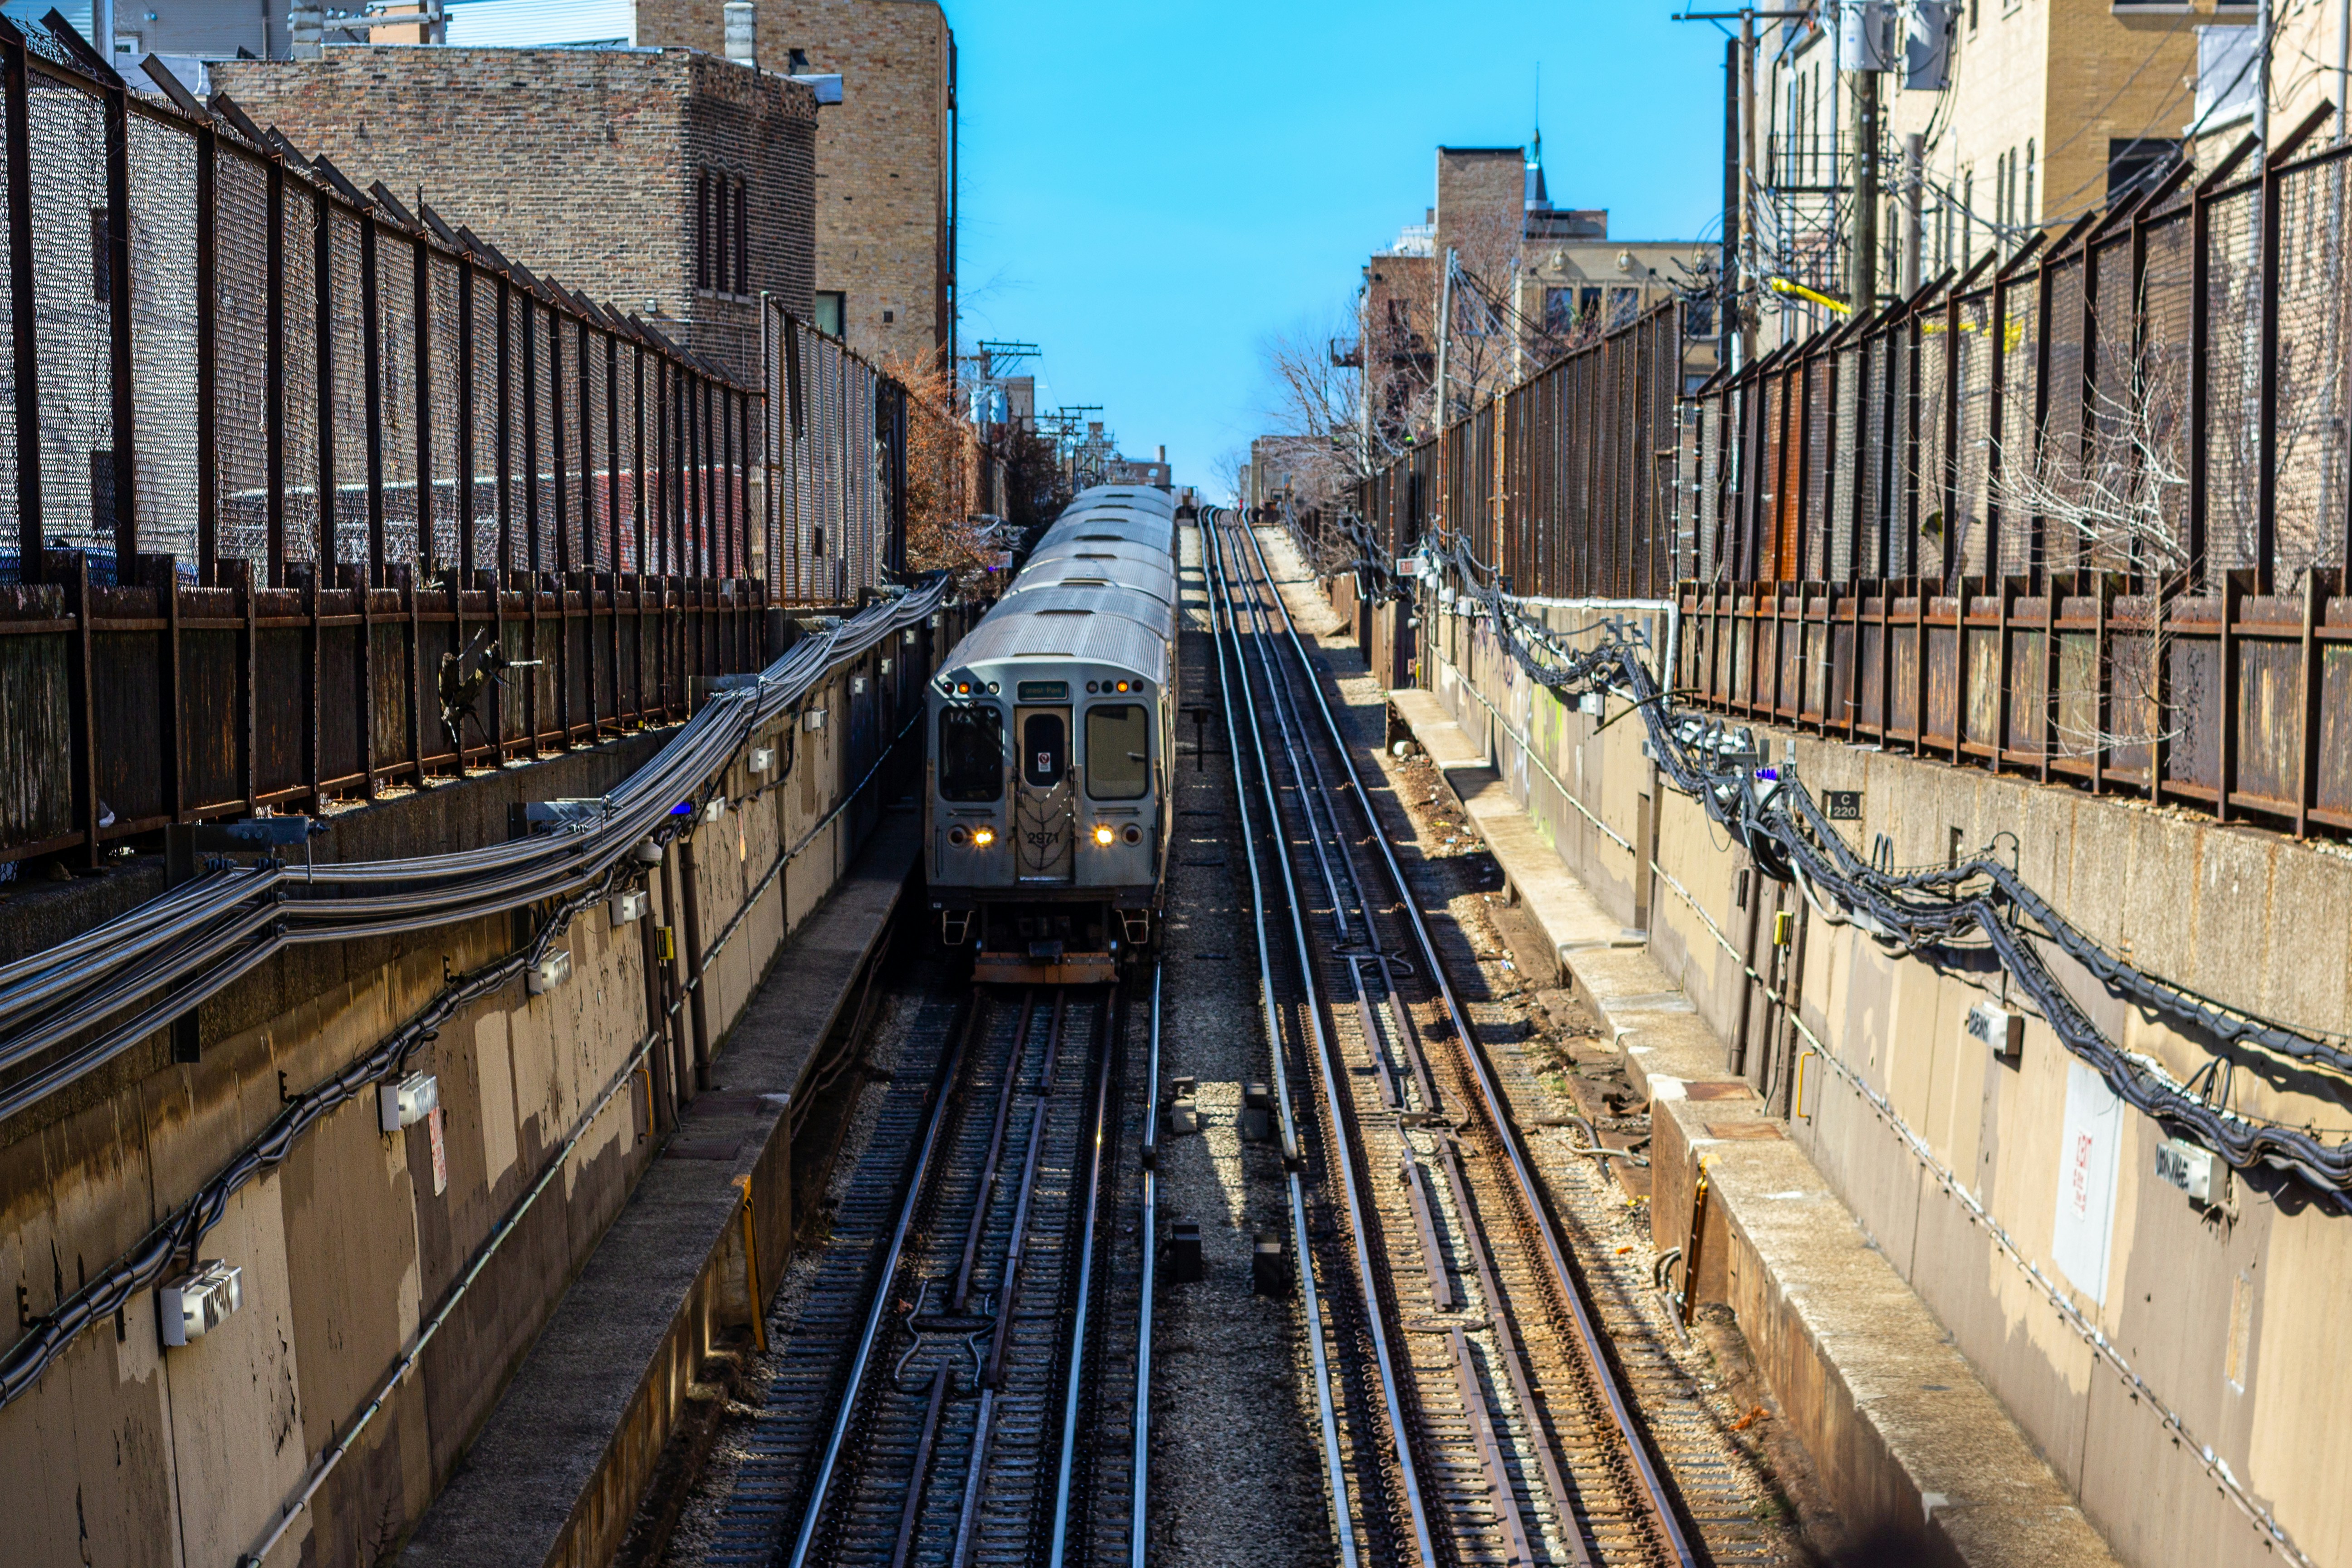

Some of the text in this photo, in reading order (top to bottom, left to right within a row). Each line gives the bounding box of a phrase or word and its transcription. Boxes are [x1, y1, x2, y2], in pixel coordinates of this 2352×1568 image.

[1841, 794, 1850, 805] C
[1834, 806, 1857, 817] 220
[1028, 832, 1059, 843] 2971
